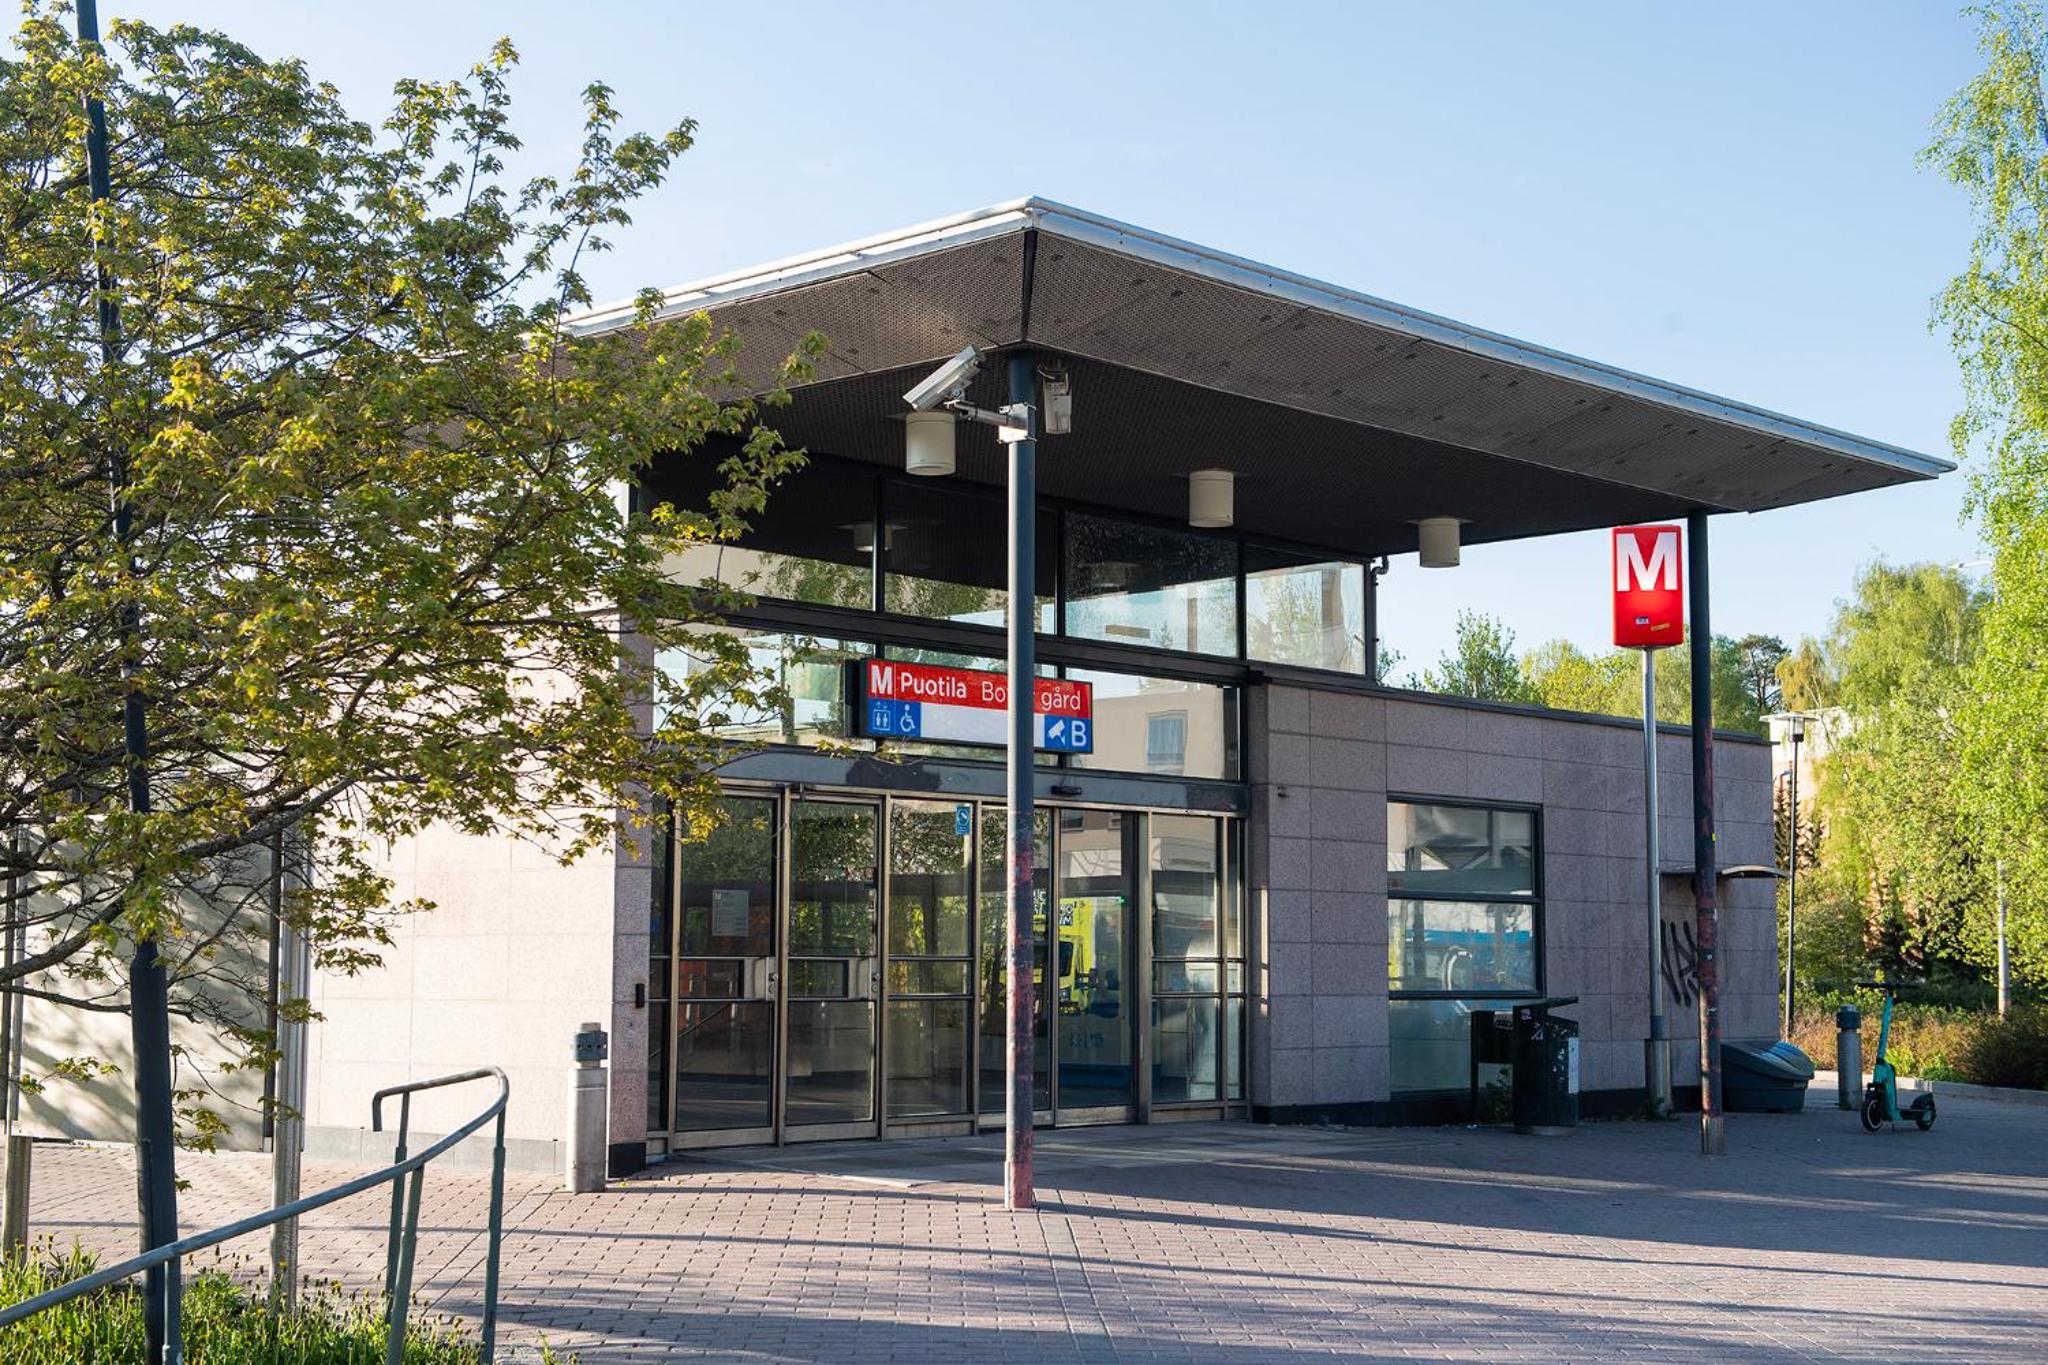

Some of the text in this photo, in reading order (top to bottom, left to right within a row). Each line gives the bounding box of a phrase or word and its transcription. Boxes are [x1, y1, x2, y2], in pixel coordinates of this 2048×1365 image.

[1616, 532, 1678, 592] M
[871, 664, 893, 695] M
[901, 671, 967, 699] Puotila
[1041, 686, 1081, 711] gård
[1071, 720, 1087, 747] B
